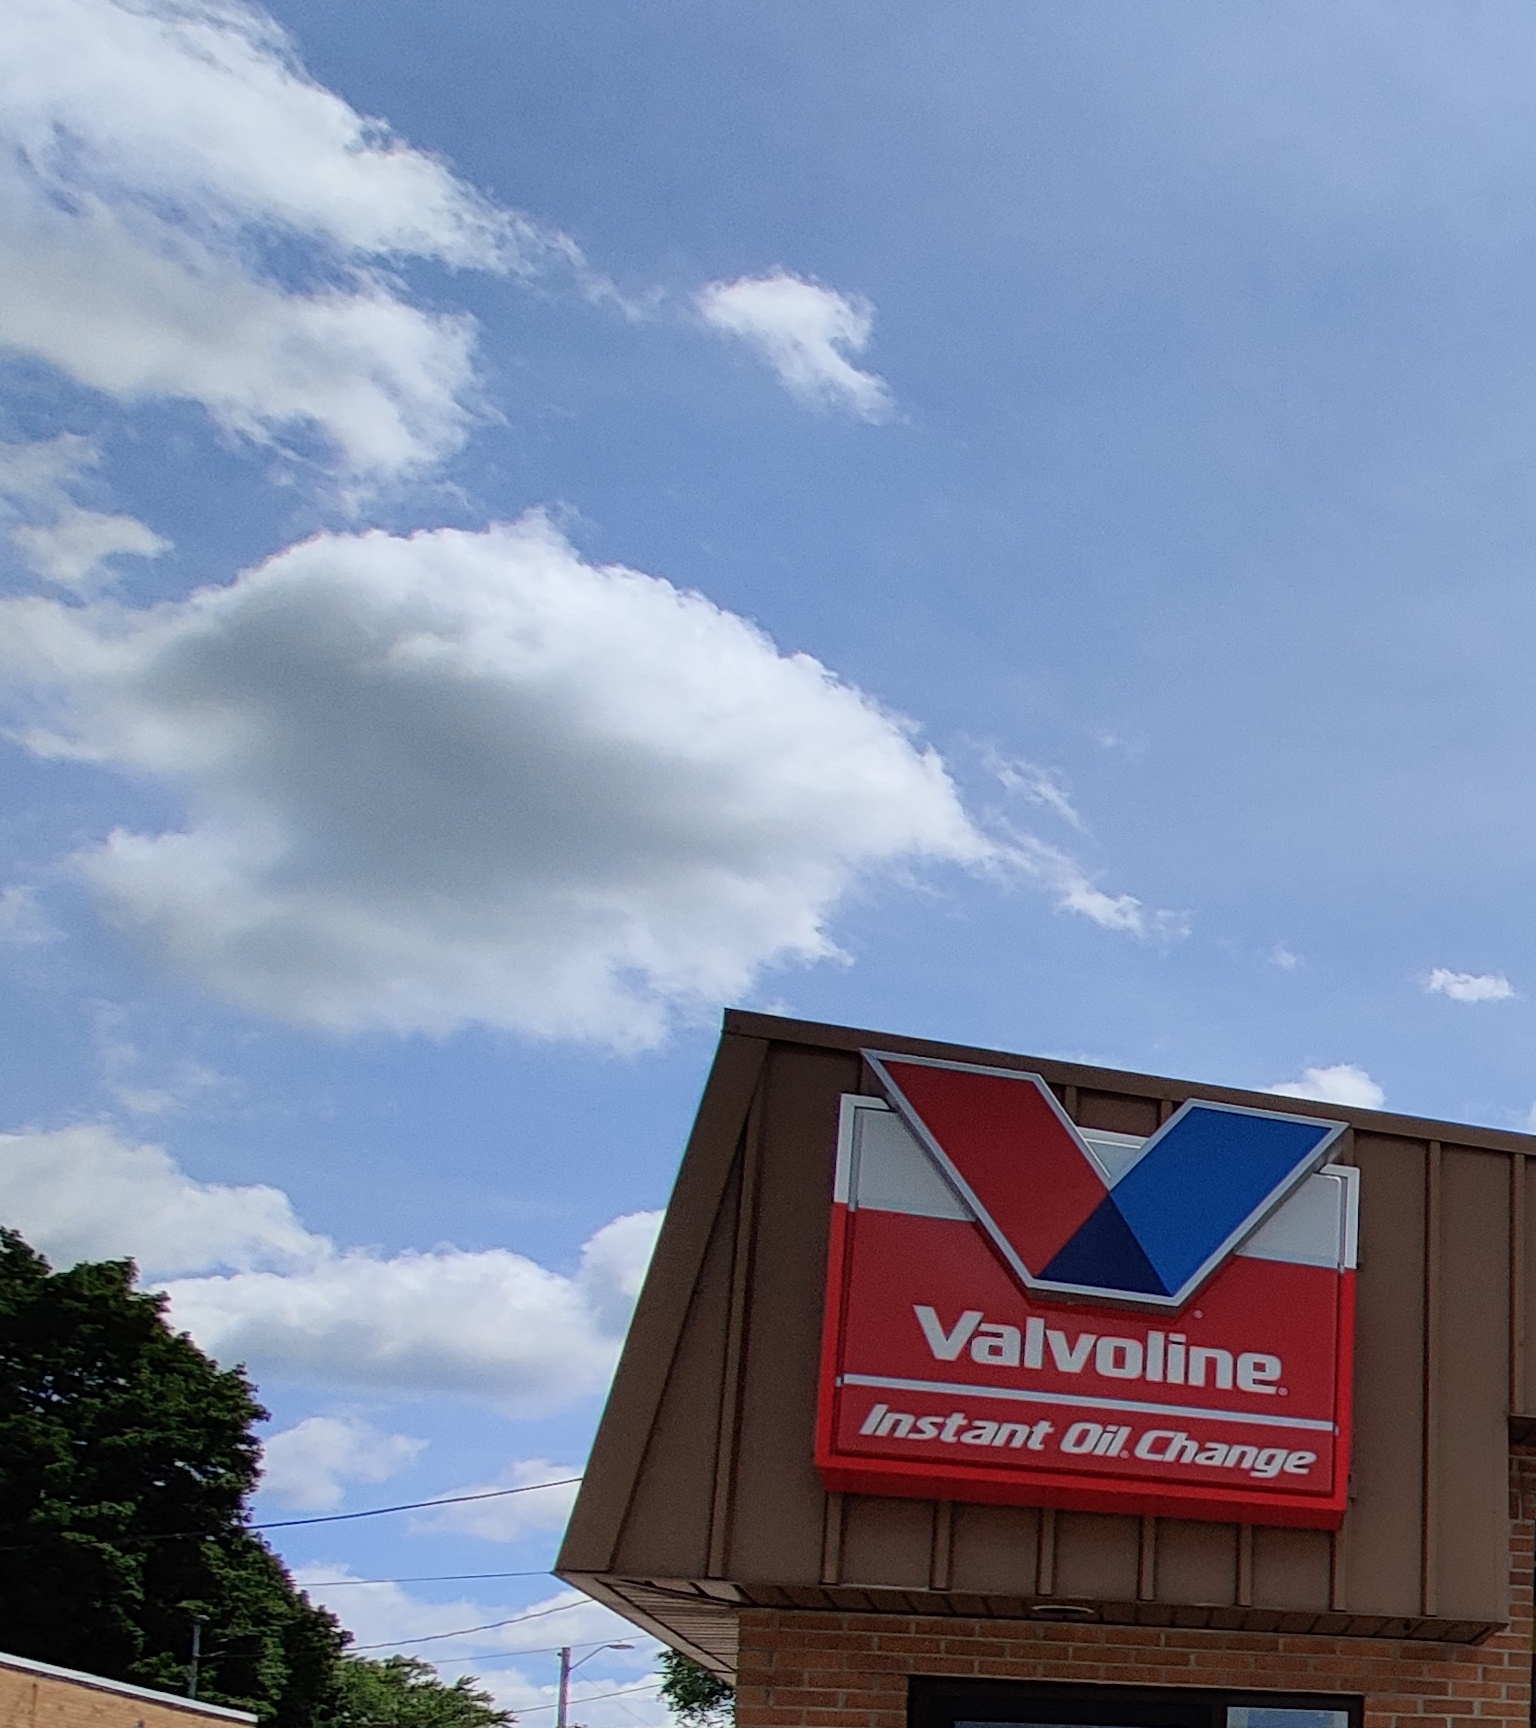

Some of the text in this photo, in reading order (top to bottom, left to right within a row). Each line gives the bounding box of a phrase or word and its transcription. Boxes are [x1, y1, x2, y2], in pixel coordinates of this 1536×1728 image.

[913, 1304, 1282, 1395] Valvoline
[859, 1403, 1317, 1479] Instant Oil Change
